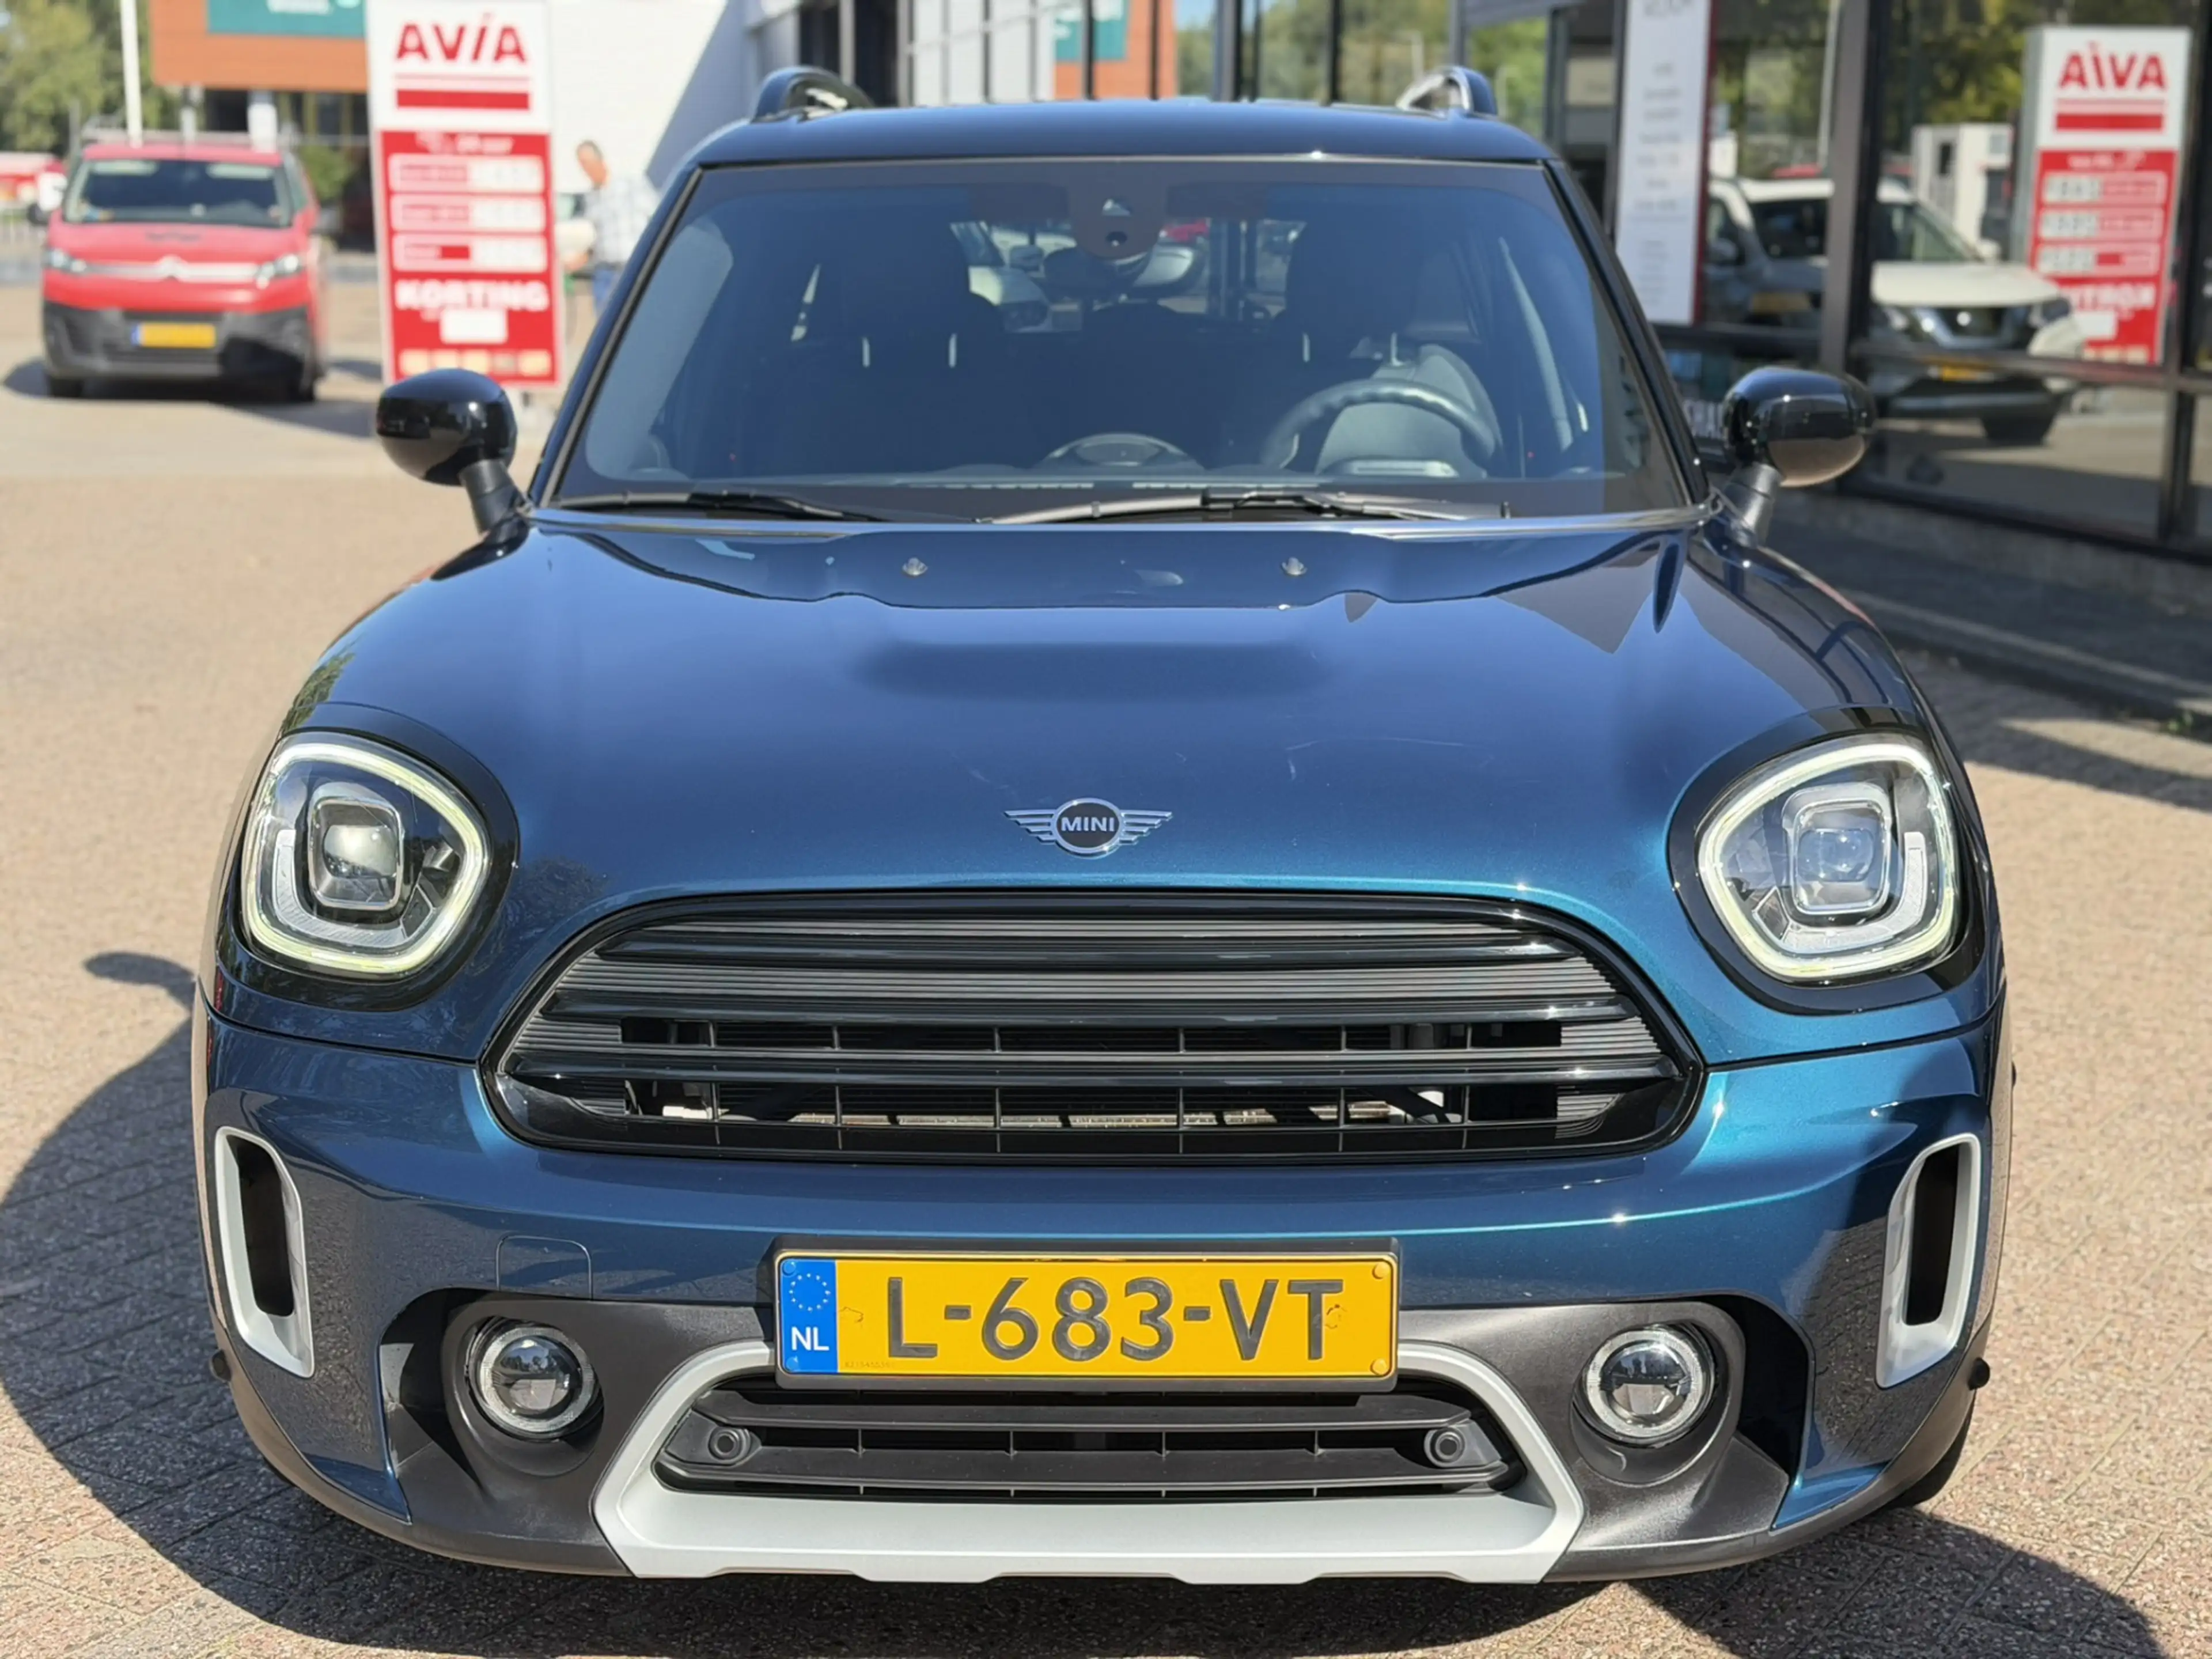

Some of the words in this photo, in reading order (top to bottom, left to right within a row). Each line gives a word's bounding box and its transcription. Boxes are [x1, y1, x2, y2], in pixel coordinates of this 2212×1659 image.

[1061, 817, 1115, 831] MINI
[887, 1277, 1344, 1361] L-683-VT
[791, 1326, 830, 1351] NL
